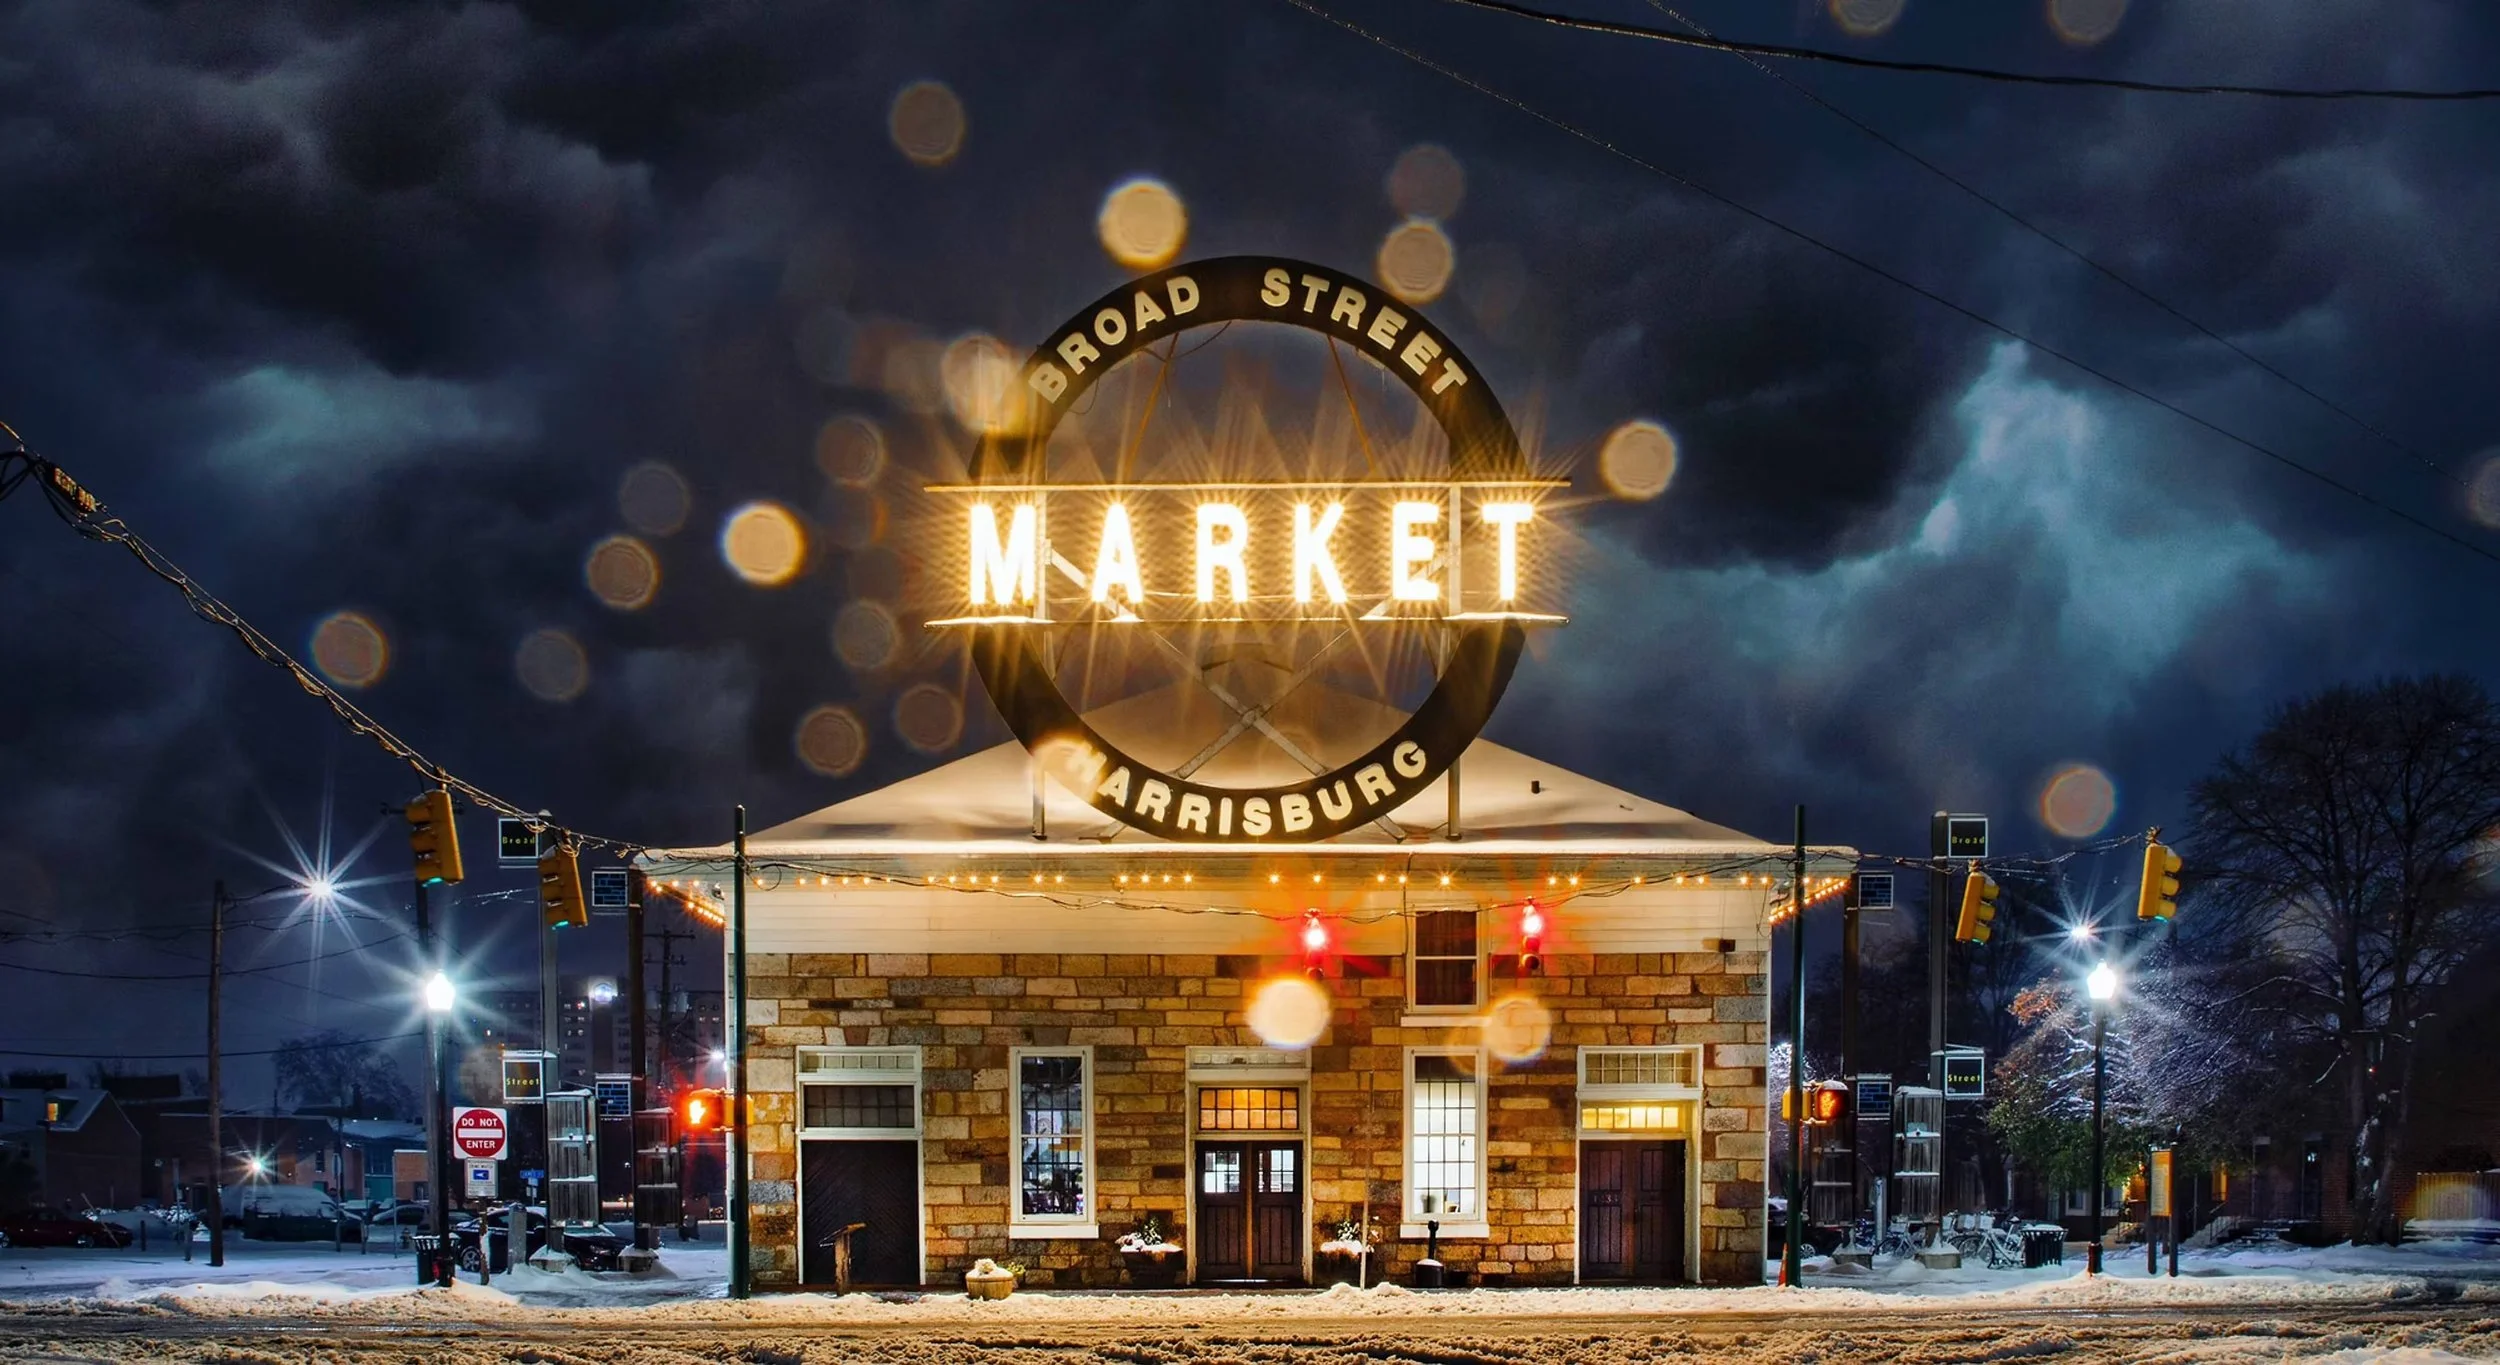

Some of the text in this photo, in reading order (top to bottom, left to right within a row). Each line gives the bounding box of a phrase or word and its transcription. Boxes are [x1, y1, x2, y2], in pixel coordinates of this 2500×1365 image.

[1029, 267, 1468, 403] BROAD STREET
[969, 501, 1534, 606] MARKET
[502, 836, 536, 845] Broad
[1951, 836, 1985, 845] Broad
[506, 1077, 540, 1086] Street
[1948, 1074, 1981, 1083] Street
[461, 1117, 498, 1127] DO NOT
[466, 1140, 496, 1149] ENTER
